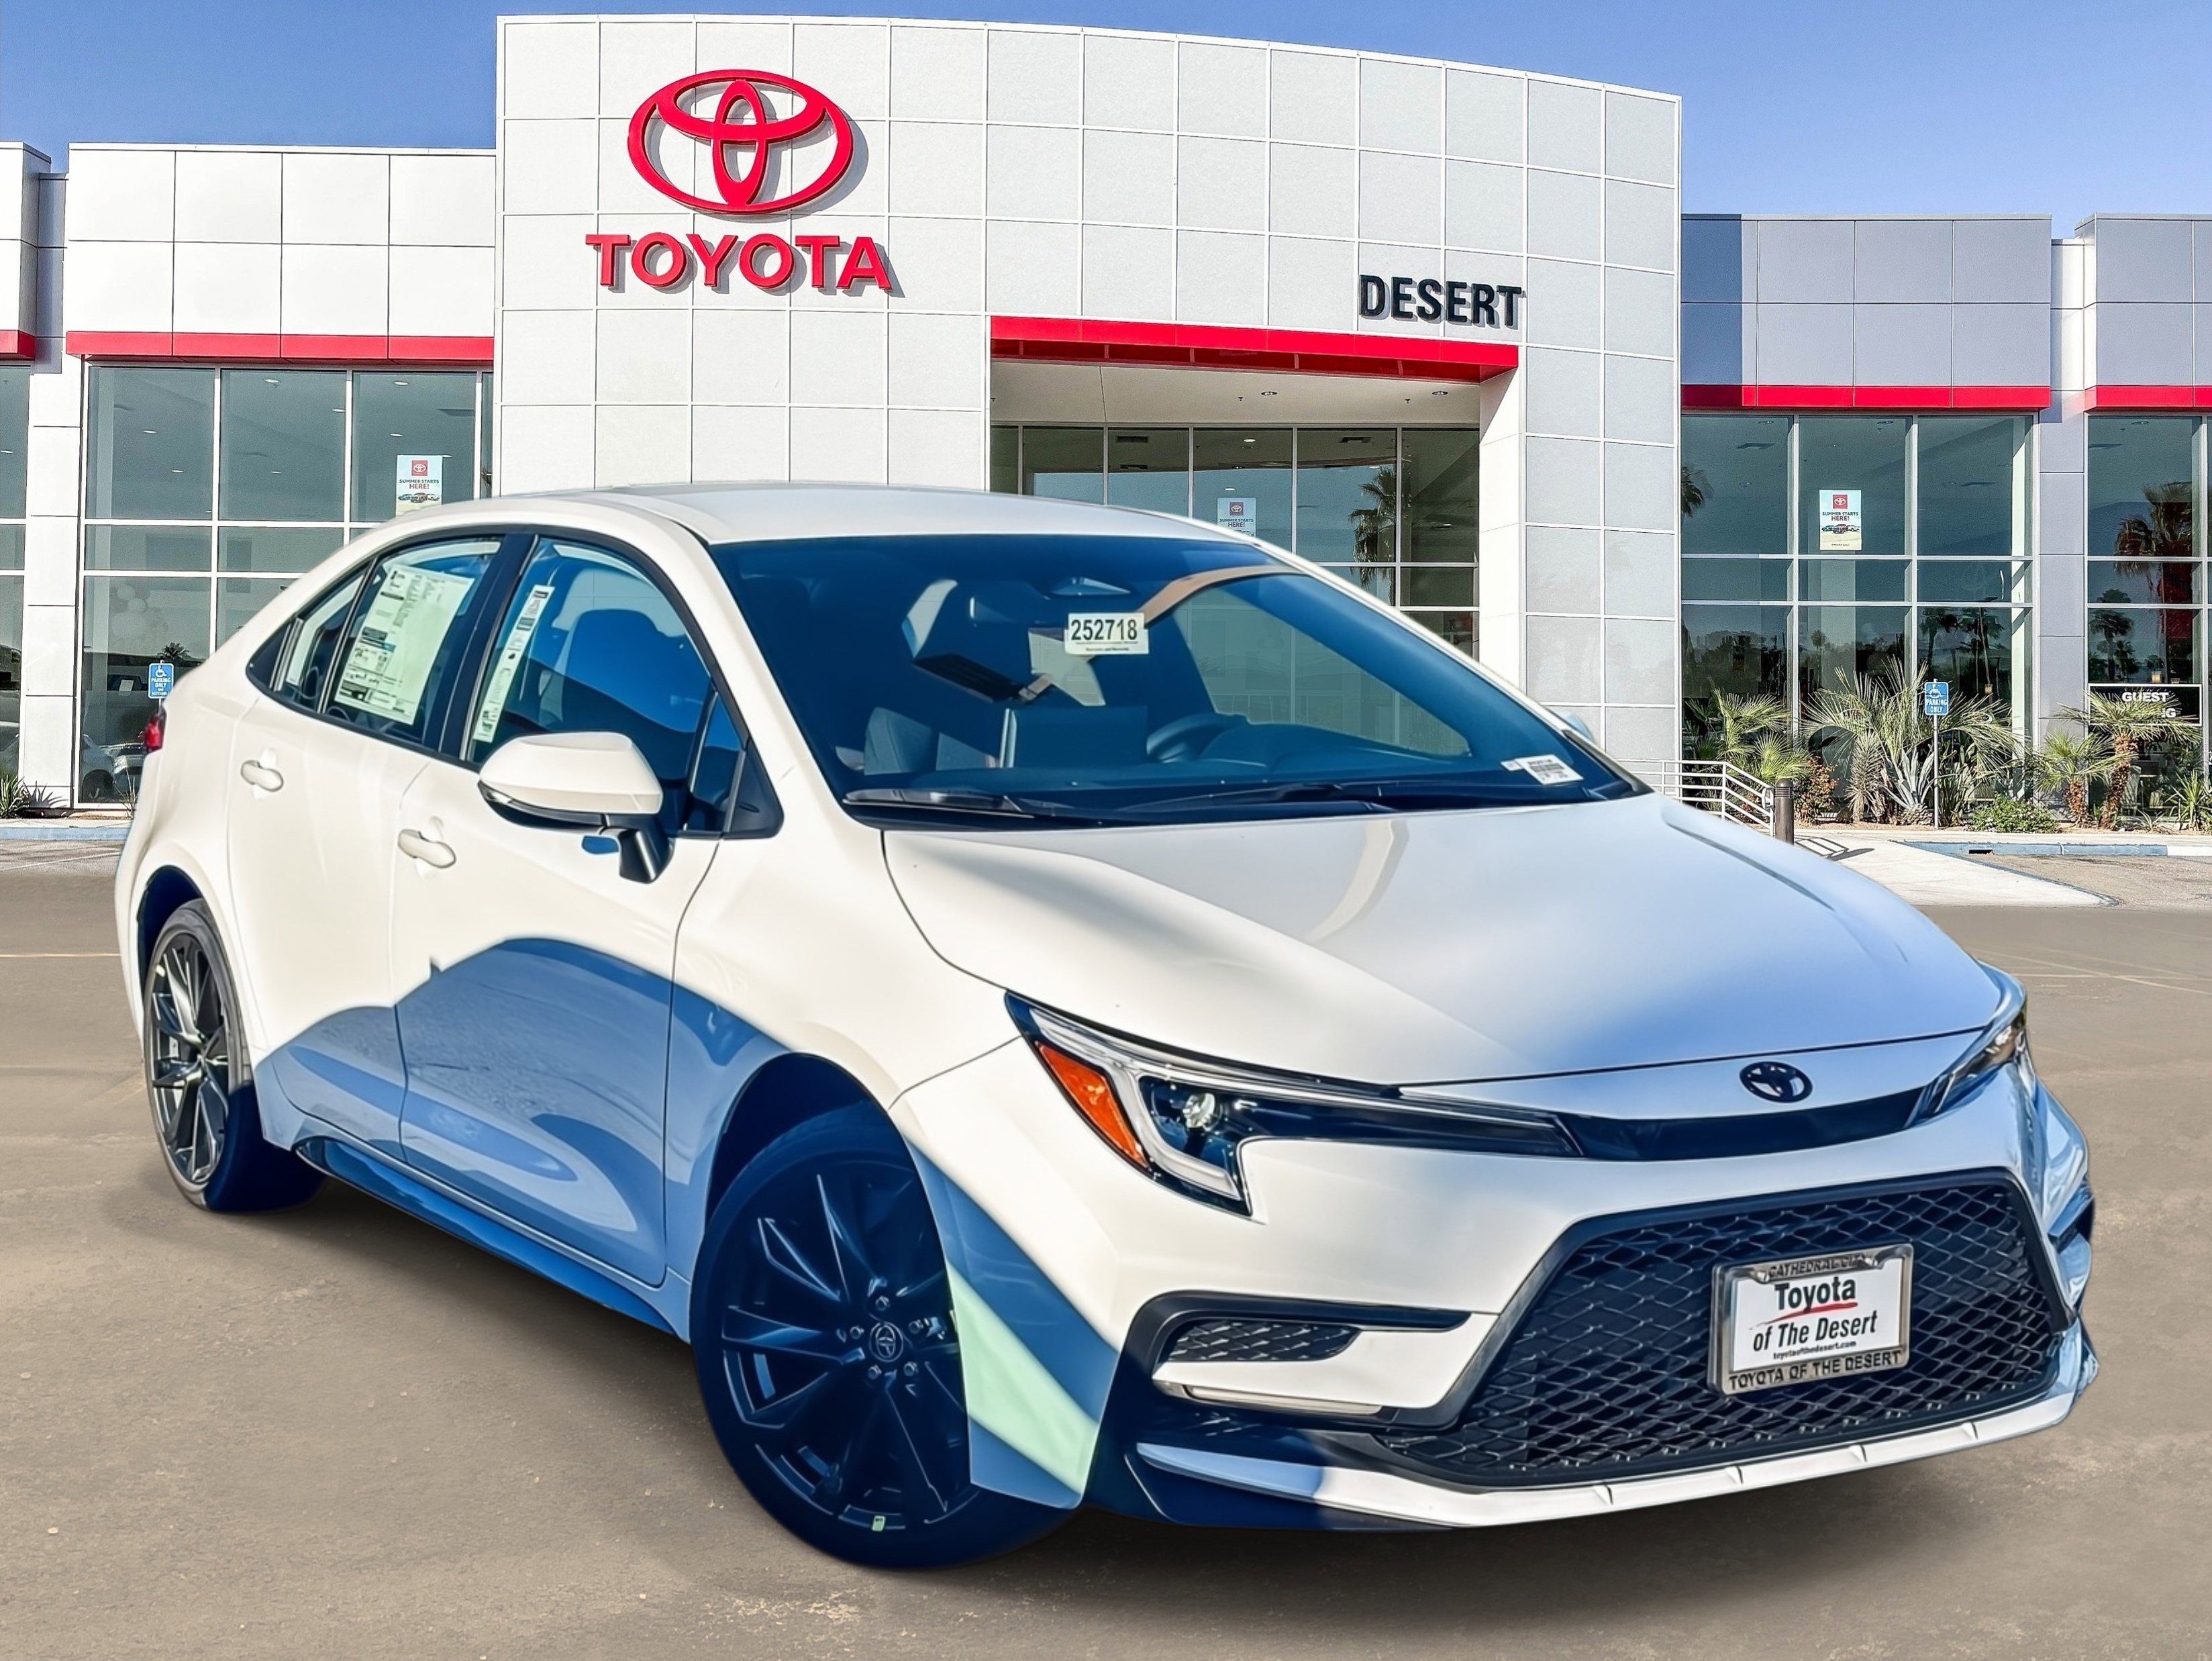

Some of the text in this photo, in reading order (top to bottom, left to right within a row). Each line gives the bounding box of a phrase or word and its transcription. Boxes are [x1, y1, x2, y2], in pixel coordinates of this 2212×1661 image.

[585, 232, 892, 291] TOYOTA
[1358, 274, 1522, 326] DESERT
[1070, 619, 1138, 640] 252718
[2121, 691, 2169, 703] GUEST
[1768, 1256, 1840, 1277] CATHEDRAL
[1774, 1276, 1856, 1314] Toyota
[1753, 1310, 1878, 1352] of The Desert
[1729, 1350, 1901, 1390] TOYOTA OF THE DESERT
